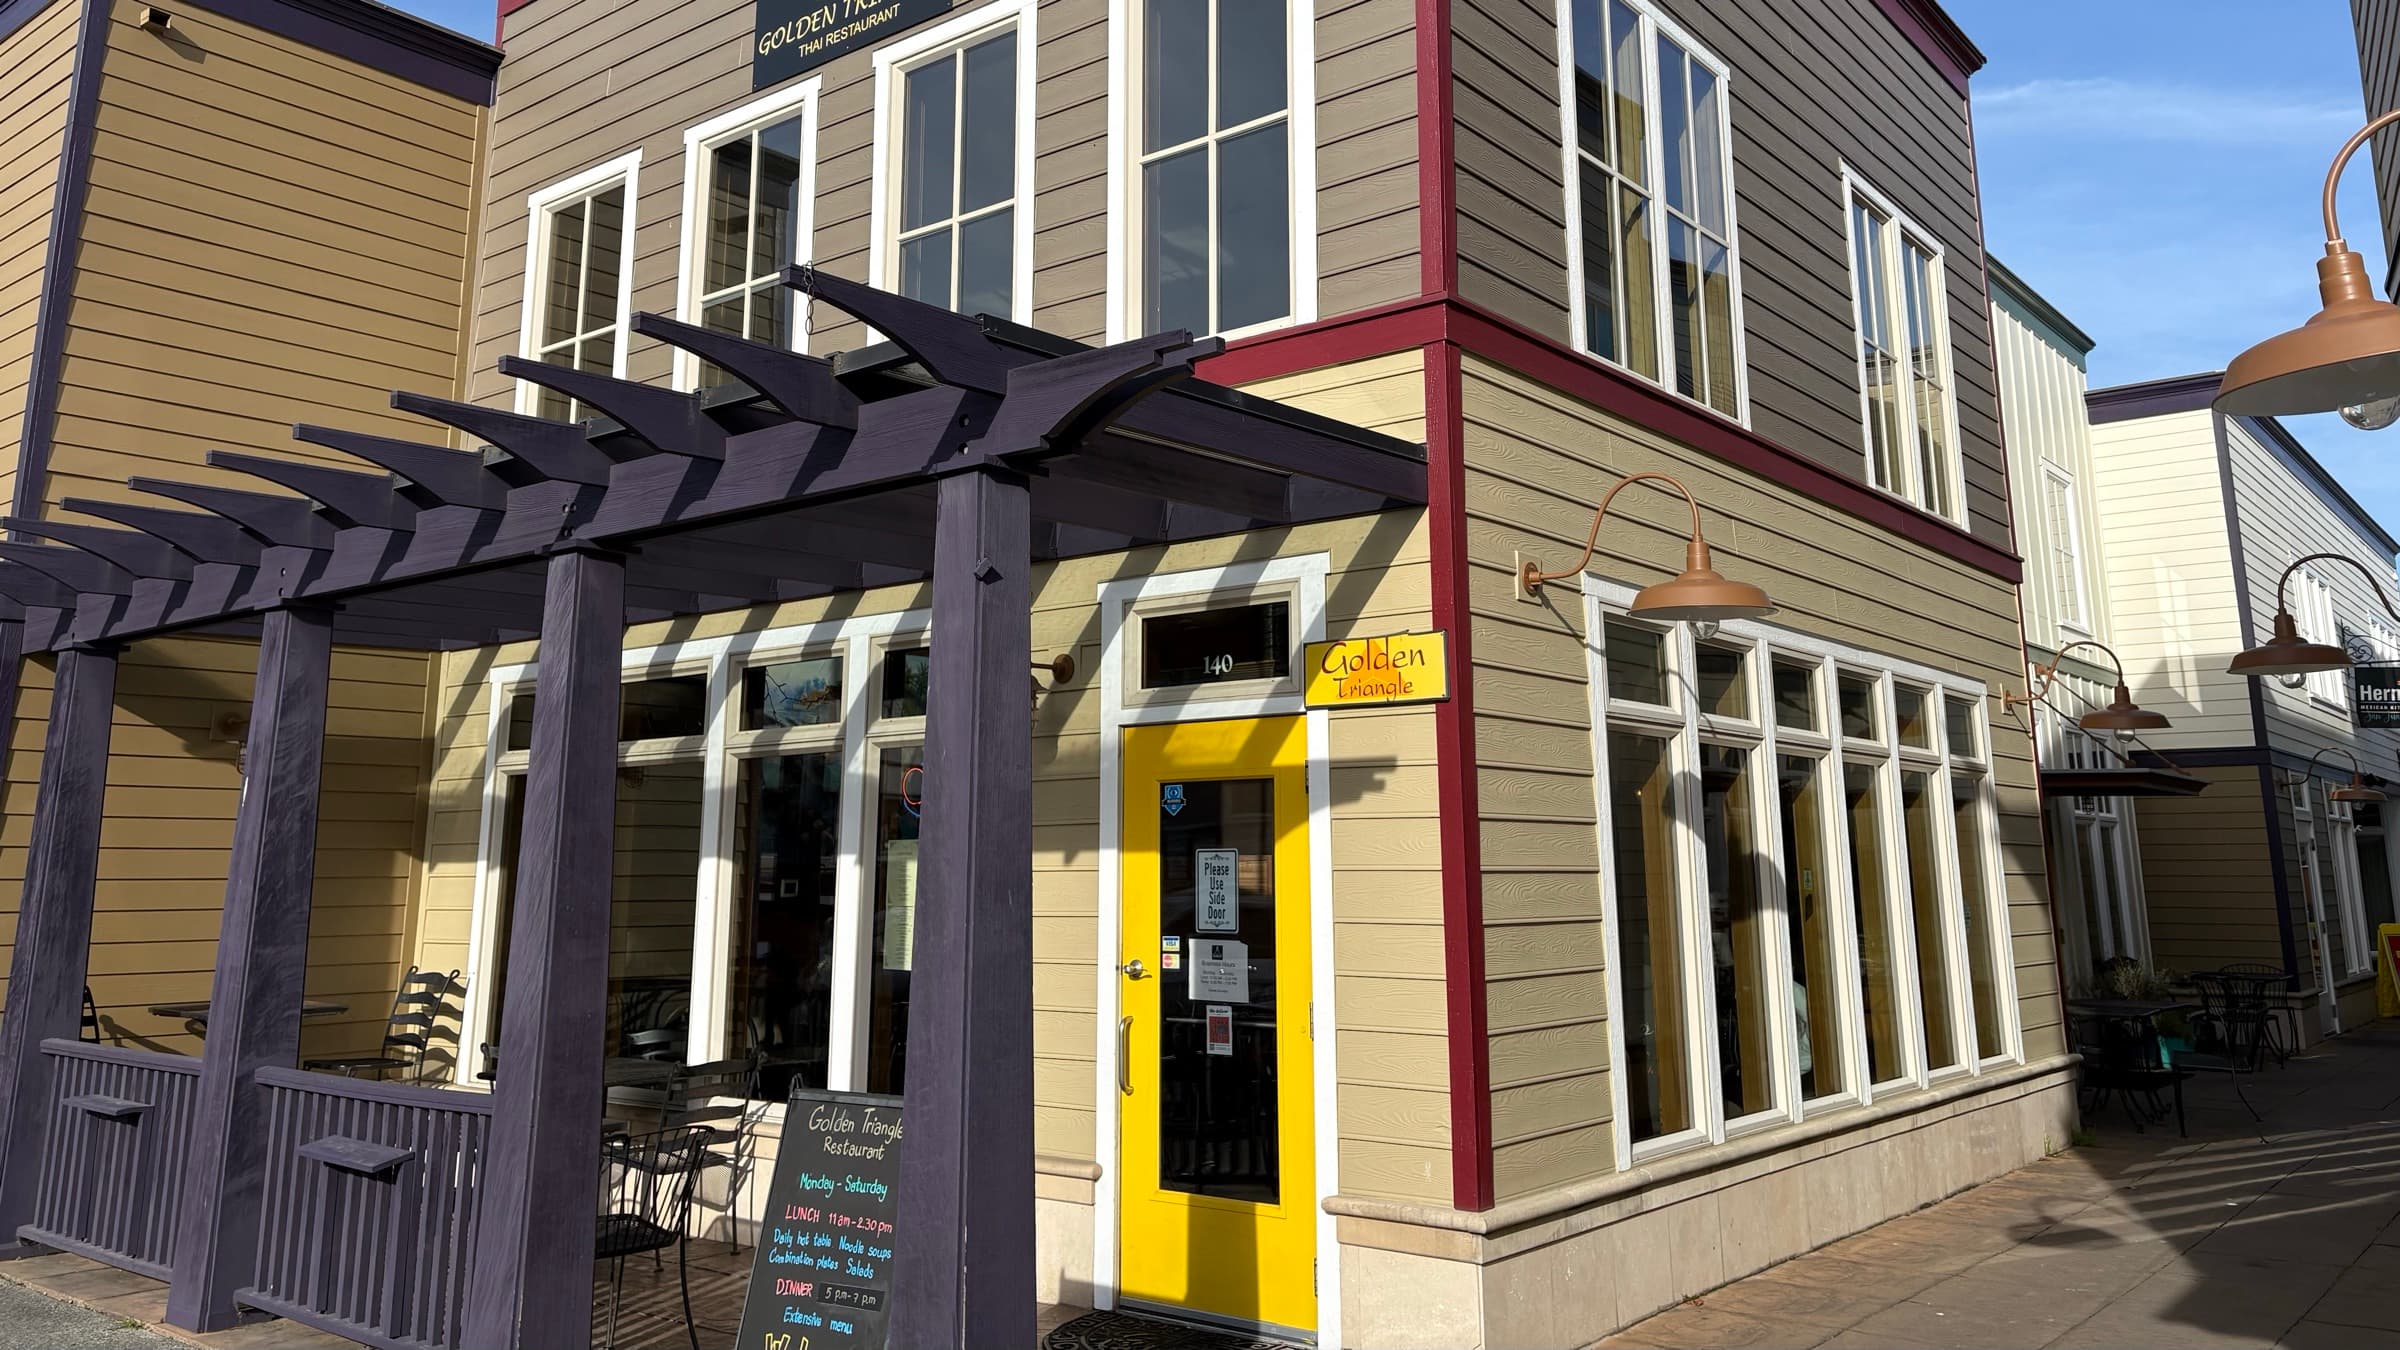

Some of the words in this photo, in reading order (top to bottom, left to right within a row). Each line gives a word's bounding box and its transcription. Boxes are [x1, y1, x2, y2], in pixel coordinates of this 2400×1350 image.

[758, 2, 837, 56] GOLDEN
[843, 0, 882, 19] TR
[798, 42, 823, 58] THAI
[825, 3, 901, 47] RESTAURANT
[1202, 654, 1233, 676] 140
[1321, 635, 1426, 674] Golden
[1333, 671, 1415, 702] Triangle
[1204, 861, 1230, 876] Please
[1210, 876, 1224, 890] Use
[1208, 905, 1226, 920] Door
[1209, 890, 1226, 905] Side
[808, 1104, 855, 1132] Golden
[861, 1107, 903, 1145] Triangle
[823, 1135, 885, 1161] Restaurant
[800, 1172, 835, 1199] Monday
[844, 1174, 888, 1203] Saturday
[785, 1203, 821, 1223] LUNCH
[773, 1227, 794, 1248] Daily
[796, 1231, 810, 1246] hot
[813, 1232, 832, 1247] table
[838, 1234, 865, 1255] Noodle
[867, 1246, 892, 1262] soups
[768, 1246, 814, 1266] Combination
[815, 1255, 839, 1271] plates
[845, 1257, 874, 1279] Salads
[775, 1278, 813, 1297] DINNER
[824, 1287, 833, 1299] 5
[783, 1305, 823, 1327] Extensive
[829, 1318, 854, 1335] menu
